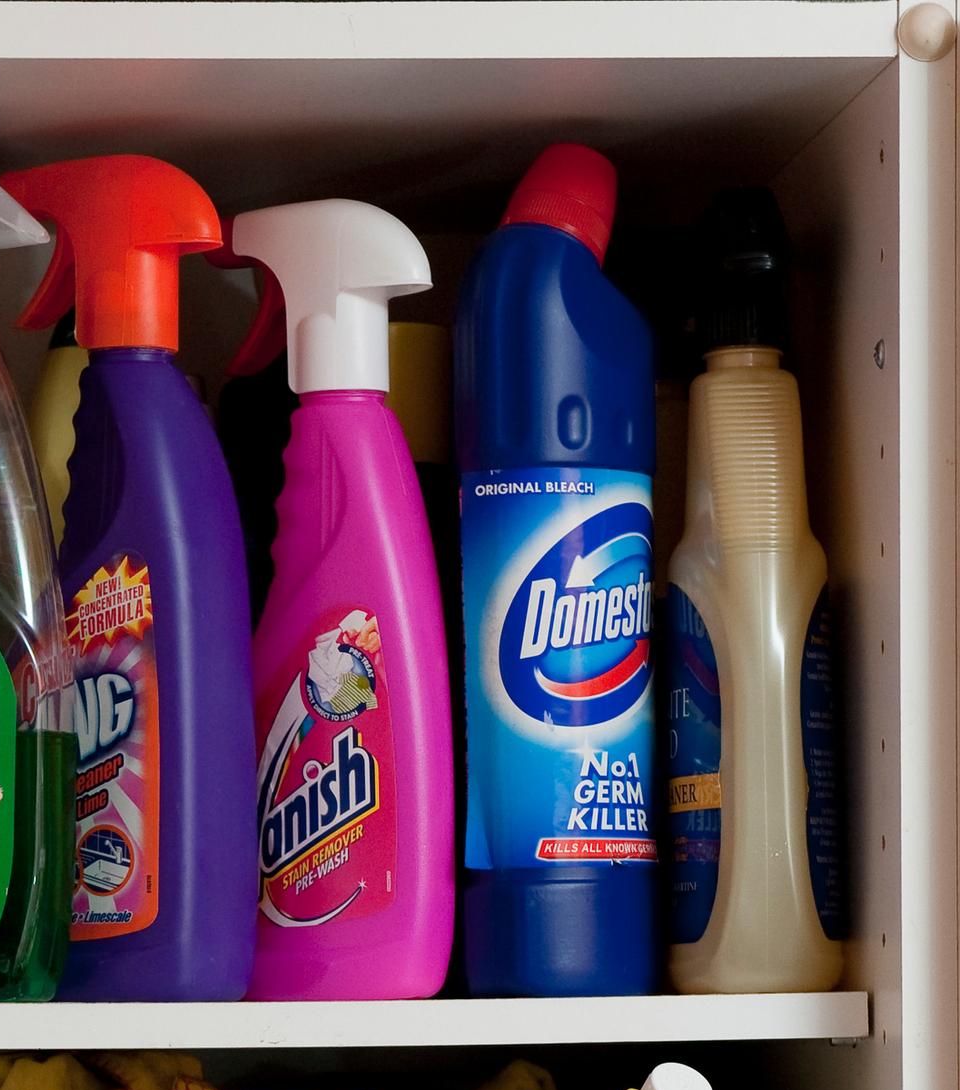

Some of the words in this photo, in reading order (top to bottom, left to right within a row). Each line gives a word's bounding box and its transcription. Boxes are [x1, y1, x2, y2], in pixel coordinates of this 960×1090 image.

[475, 482, 542, 497] ORIGINAL
[545, 481, 594, 495] BLEACH
[95, 576, 121, 597] NEW!
[79, 585, 144, 616] CONCENTRATED
[79, 600, 145, 639] FORMULA
[580, 752, 640, 778] No.1
[573, 779, 644, 805] GERM
[567, 807, 649, 832] KILLER
[282, 861, 310, 890] STAIN
[312, 824, 364, 868] REMOVER
[544, 843, 579, 854] KILLS
[581, 843, 602, 853] ALL
[605, 843, 638, 854] KNOWN
[295, 848, 349, 896] PRE-WASH
[84, 910, 132, 923] Limescale
